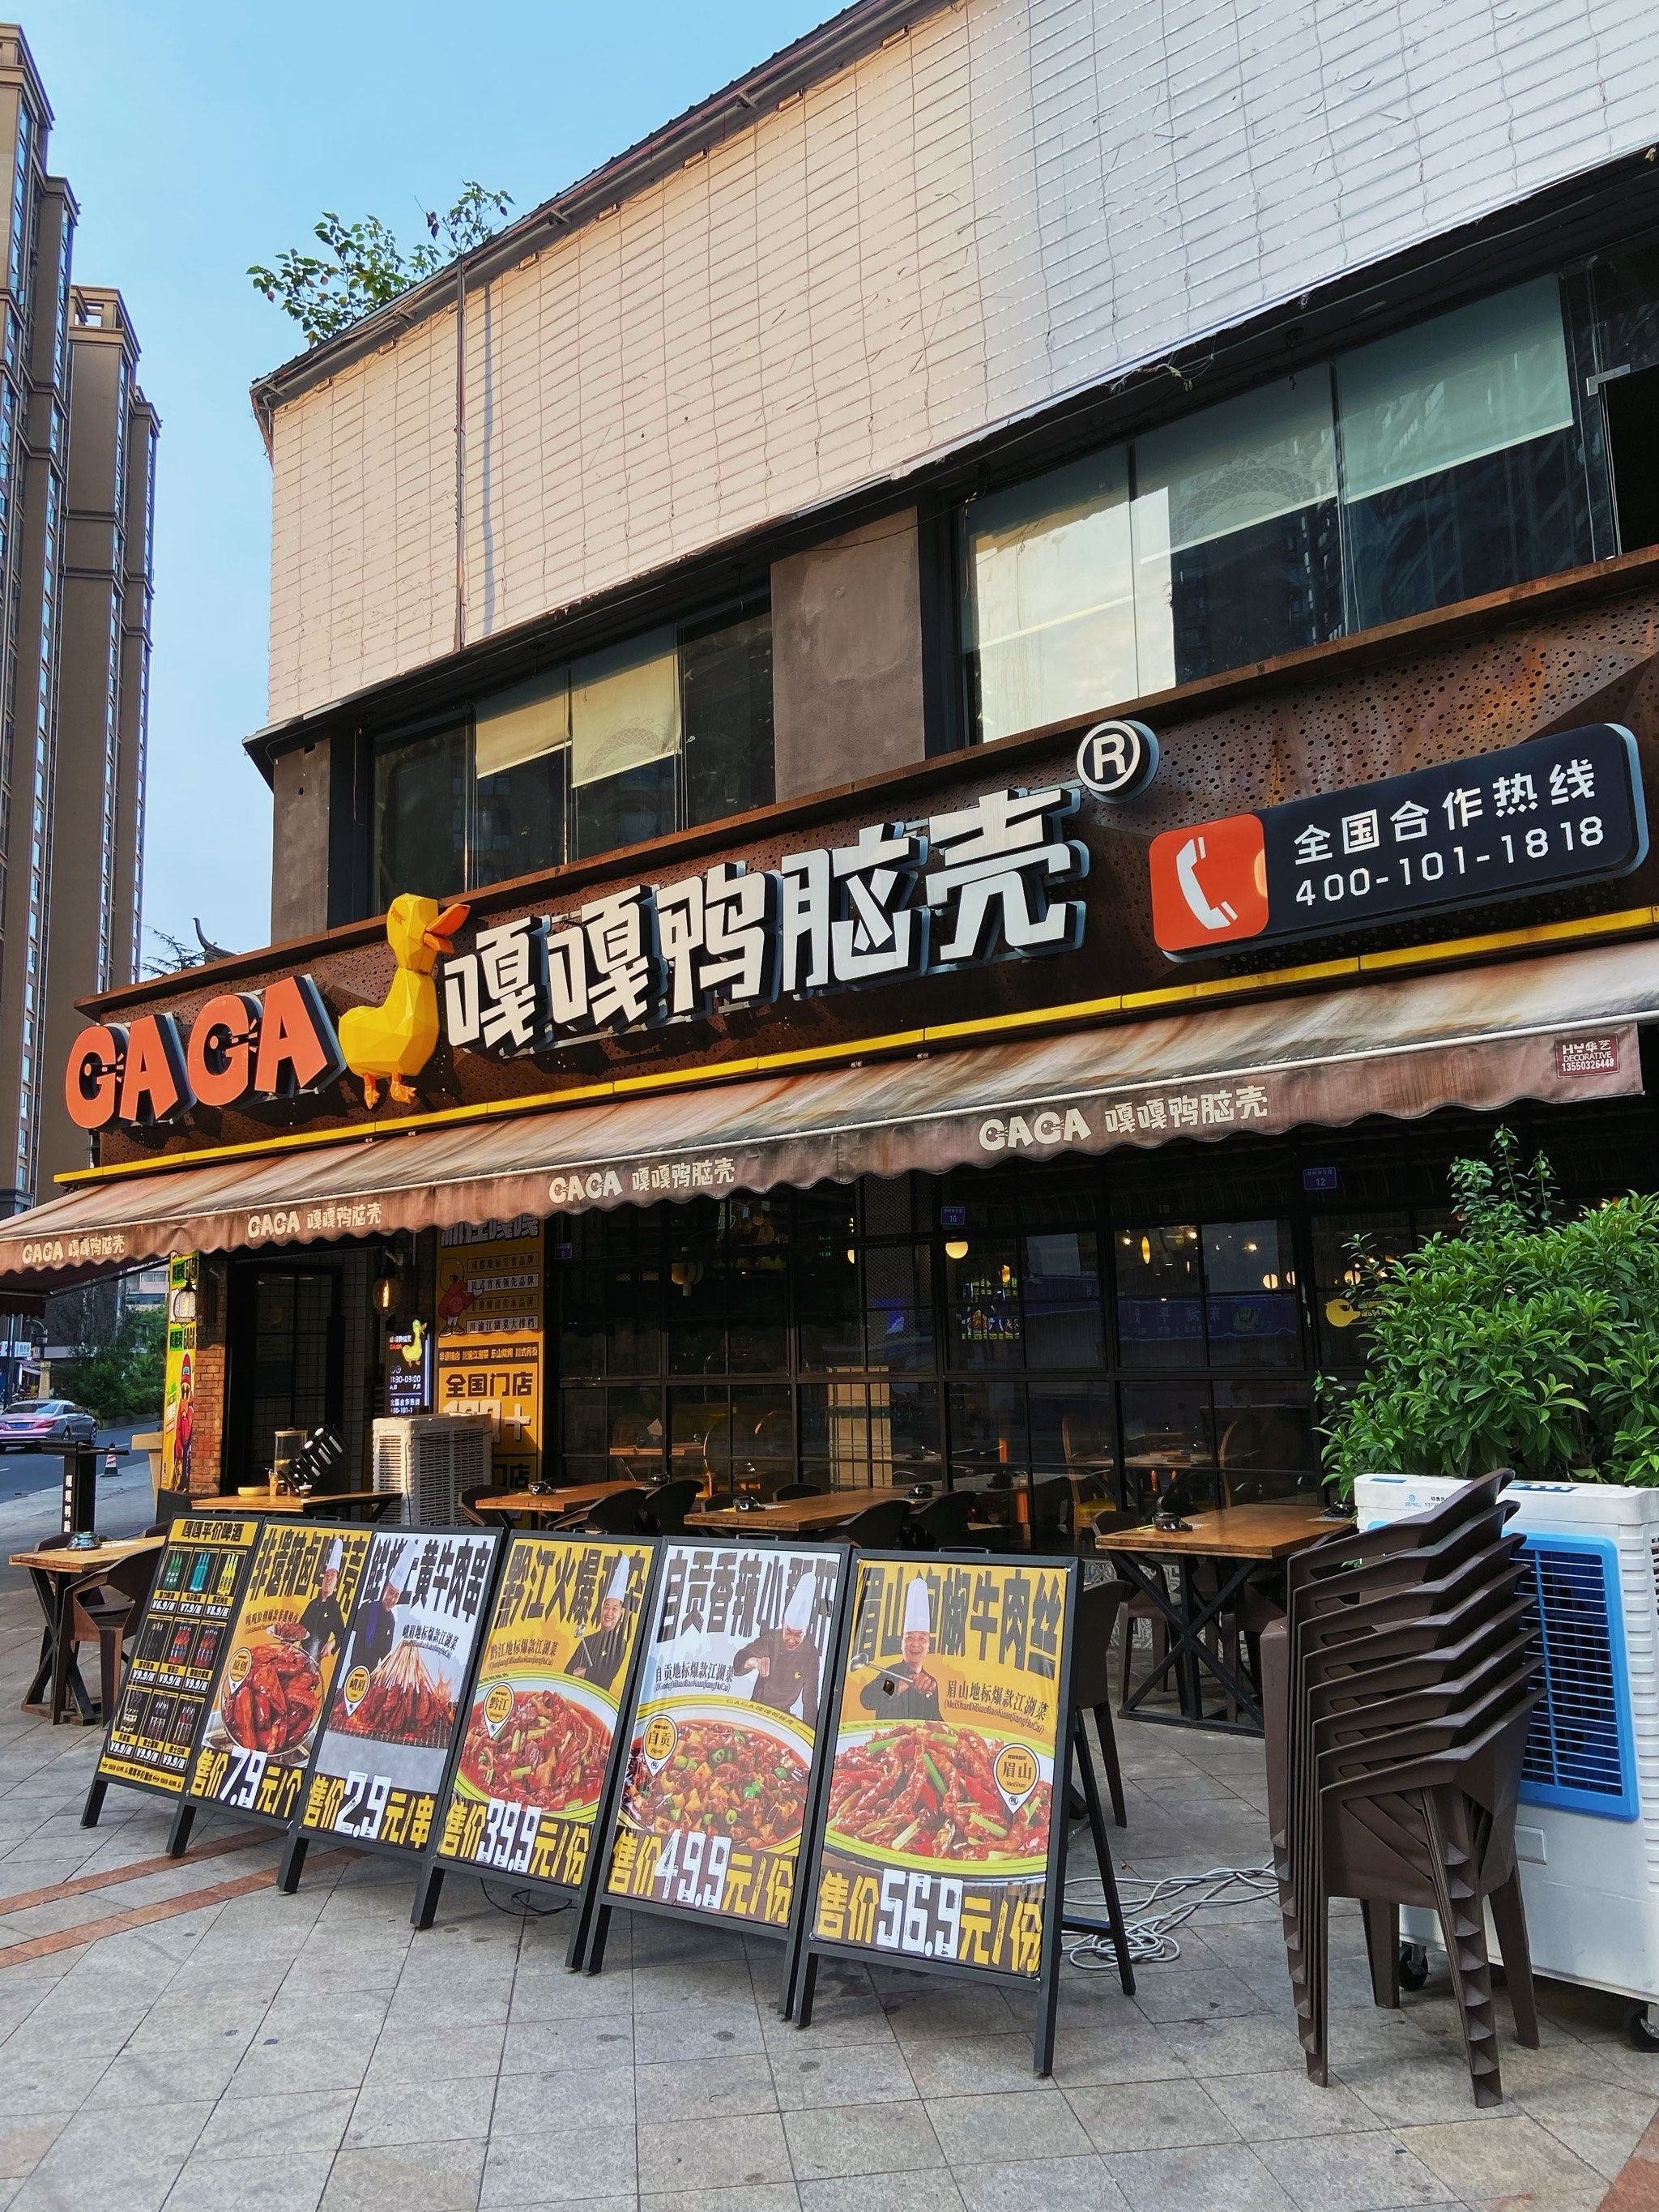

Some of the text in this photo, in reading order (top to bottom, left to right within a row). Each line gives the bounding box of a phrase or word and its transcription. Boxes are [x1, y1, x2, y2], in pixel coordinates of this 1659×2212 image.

[1294, 758, 1594, 865] 全国合作热线
[1296, 817, 1604, 907] 400-101-1818
[445, 788, 1074, 1048] 嘎嘎鸭脑壳
[1562, 1058, 1614, 1072] 13550326448
[1563, 1051, 1612, 1062] DECORATIVE
[1104, 1084, 1268, 1134] 嘎嘎鸭脑壳
[632, 1157, 736, 1192] 嘎嘎鸭脑壳
[1316, 1177, 1326, 1186] 12
[307, 1202, 382, 1231] 嘎嘎鸭脑壳
[949, 1215, 957, 1223] 10
[68, 1235, 125, 1260] 嘎嘎鸭脑壳
[446, 1371, 533, 1398] 全国门店
[181, 1520, 244, 1541] 嘎嘎平价啤酒
[402, 1624, 459, 1650] 峨眉地标爆款江湖菜
[490, 1638, 558, 1660] 黔江地标爆款江湖菜
[232, 1659, 248, 1672] 原创
[655, 1661, 734, 1683] 自贡地标爆款江湖菜
[349, 1678, 365, 1691] 峨眉
[488, 1696, 509, 1710] 黔江
[946, 1680, 1049, 1721] 眉山地标爆款江湖菜
[648, 1731, 672, 1747] 自贡
[189, 1744, 303, 1819] 售价7.9元/个
[1003, 1761, 1032, 1779] 眉山
[302, 1771, 435, 1847] 售价2.9元/串
[438, 1798, 590, 1885] 售价39.9元/份
[608, 1827, 793, 1924] 售价49.9元/份
[820, 1868, 1043, 1972] 售价56.9元/份
